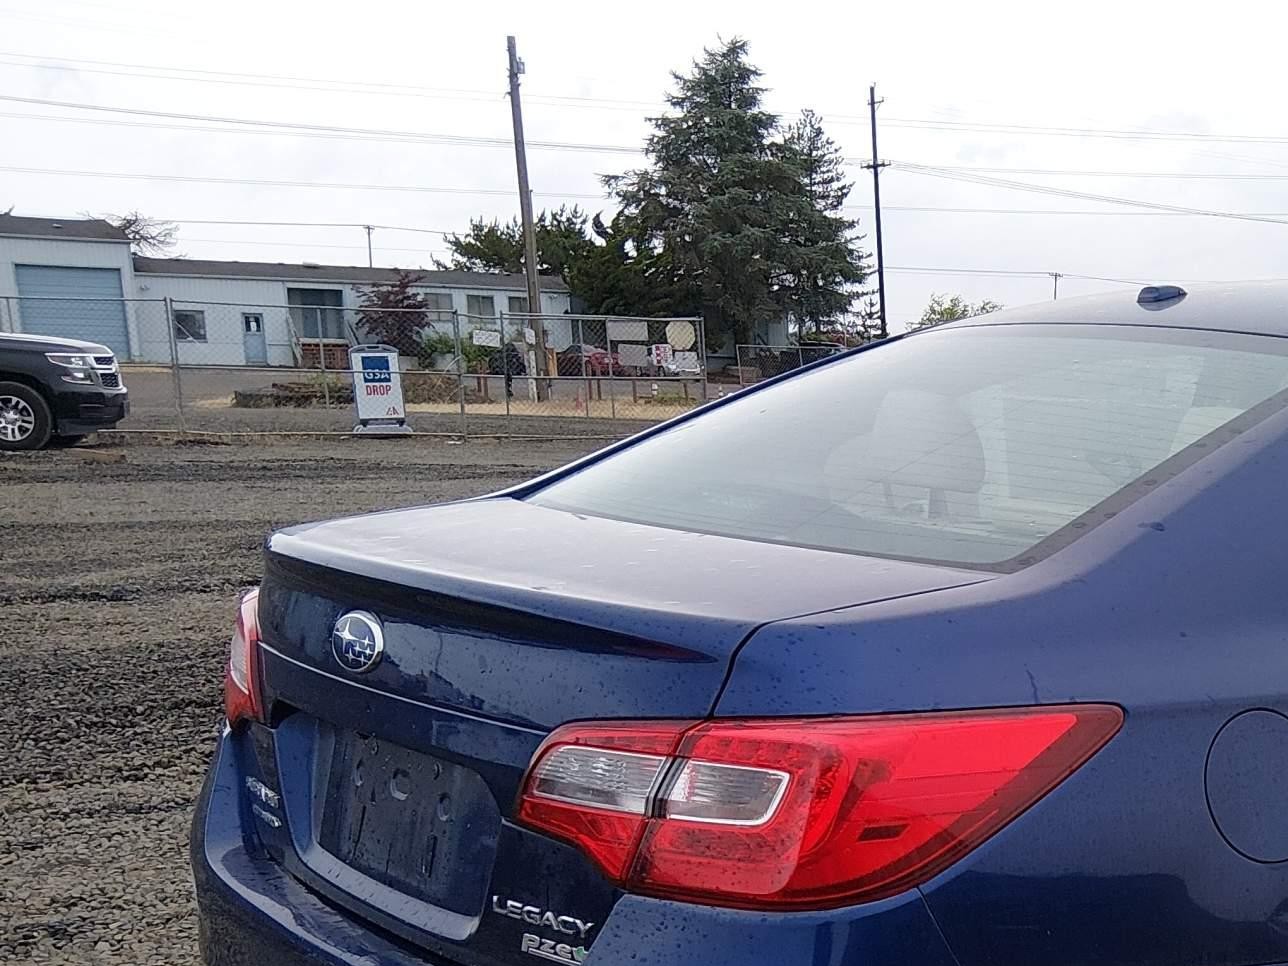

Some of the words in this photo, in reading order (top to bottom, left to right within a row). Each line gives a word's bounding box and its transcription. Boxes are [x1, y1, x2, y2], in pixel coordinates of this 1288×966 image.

[364, 368, 390, 380] GSA
[365, 384, 392, 396] DROP
[492, 895, 595, 938] LEGACY
